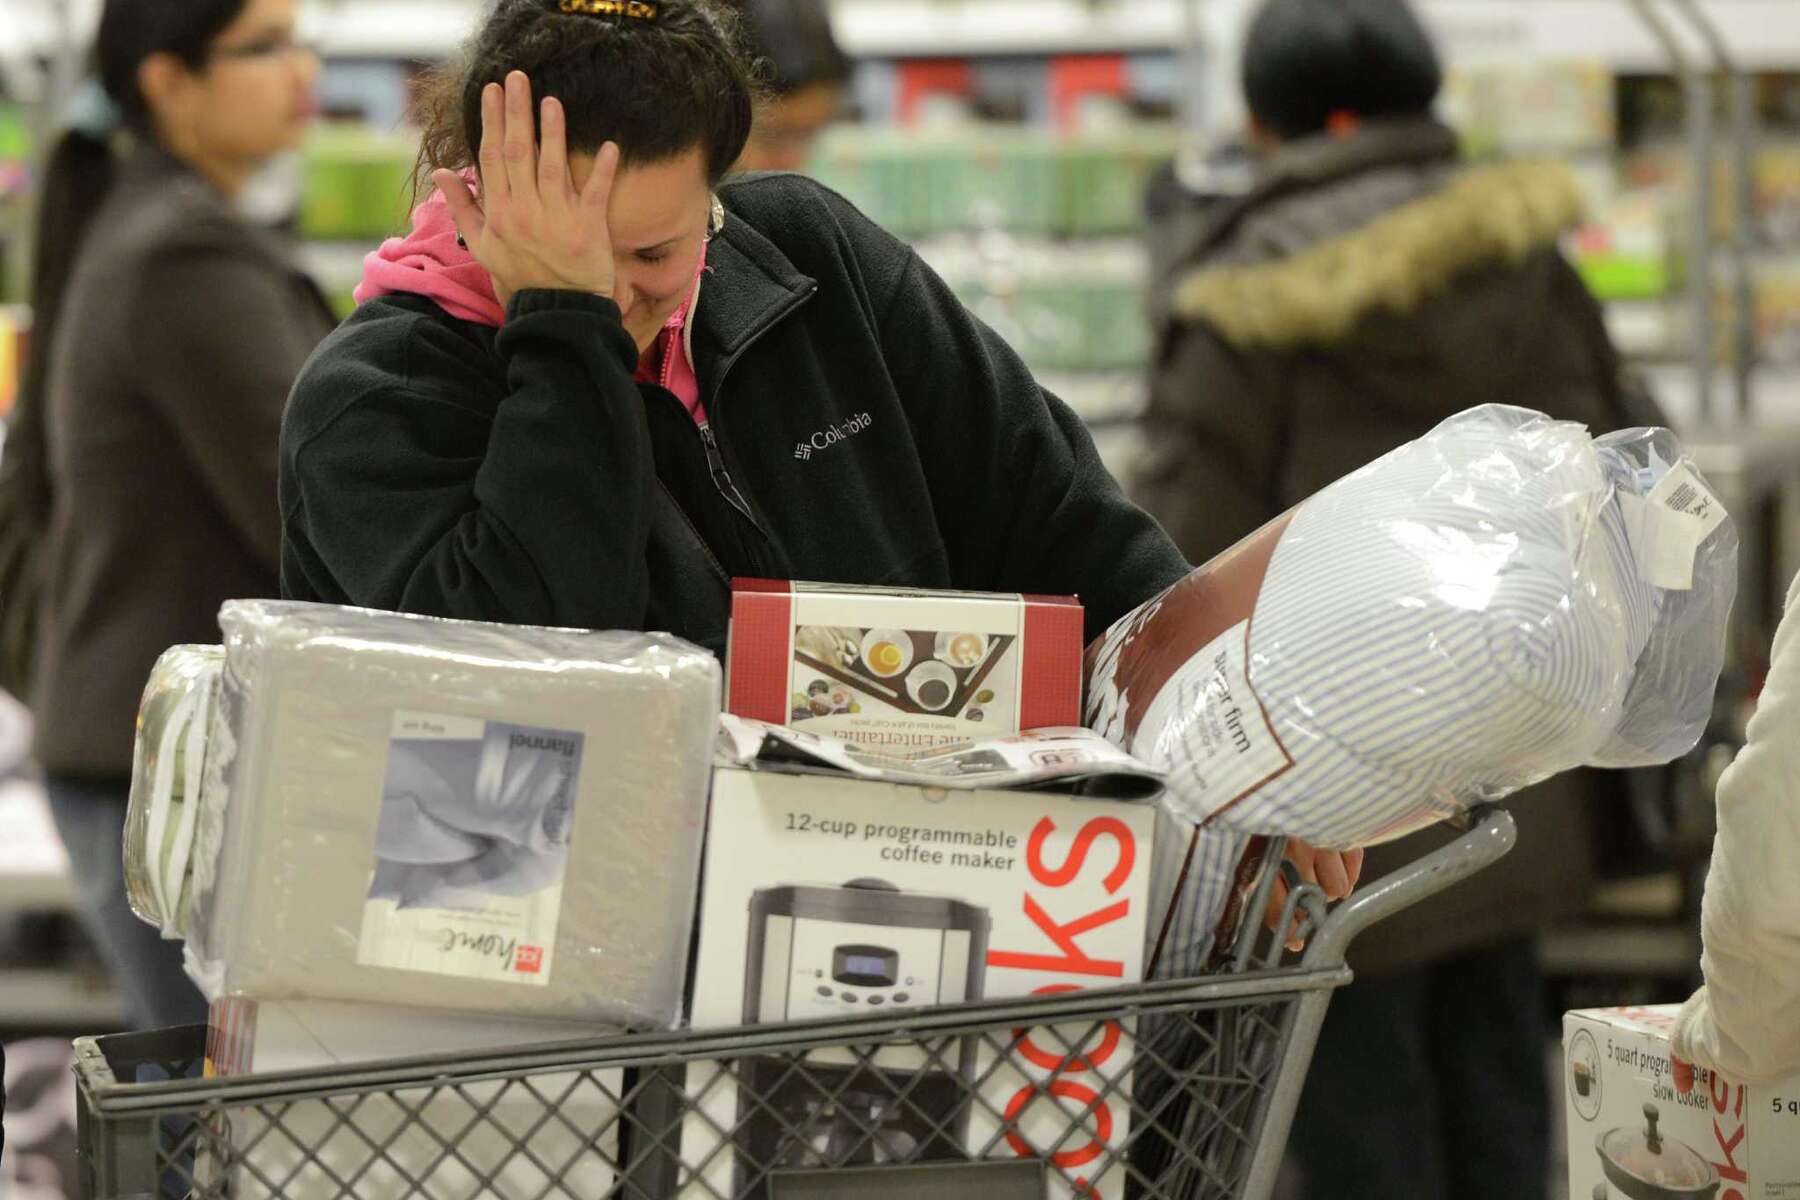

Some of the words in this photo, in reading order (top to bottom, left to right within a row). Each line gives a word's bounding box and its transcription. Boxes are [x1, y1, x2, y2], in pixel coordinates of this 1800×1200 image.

[509, 733, 576, 758] flannel
[1225, 707, 1251, 753] firm
[786, 812, 856, 838] 12-cup
[864, 822, 1018, 848] programmable
[880, 845, 943, 864] coffee
[951, 853, 1016, 870] maker
[443, 928, 517, 971] home
[987, 815, 1137, 1200] ooks
[1607, 1038, 1614, 1059] 5
[1615, 1046, 1638, 1066] quart
[1640, 1053, 1708, 1083] prograble
[1652, 1079, 1674, 1101] slow
[1772, 1098, 1783, 1113] 5
[1788, 1100, 1800, 1116] q
